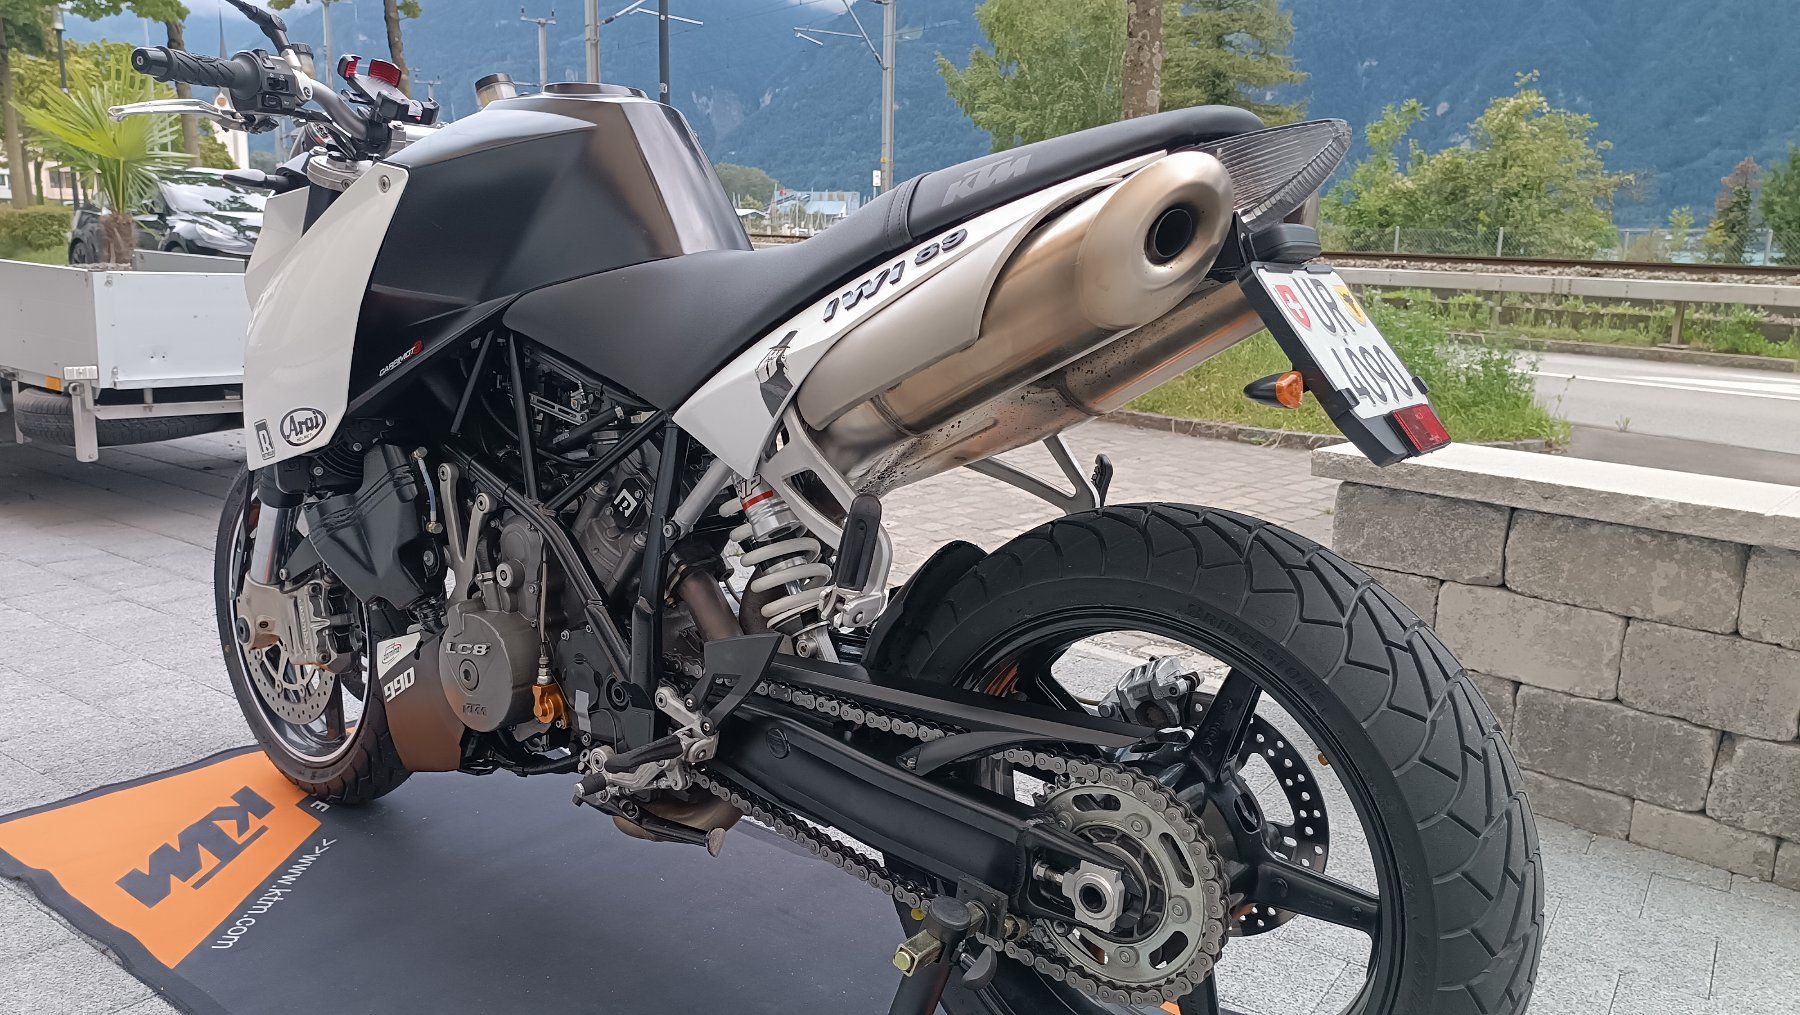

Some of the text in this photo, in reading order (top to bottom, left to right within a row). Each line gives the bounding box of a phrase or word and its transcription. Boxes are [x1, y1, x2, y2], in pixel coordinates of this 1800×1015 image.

[940, 154, 1032, 208] KTM
[914, 228, 968, 265] 89
[1291, 277, 1356, 335] UR
[1331, 344, 1413, 408] 4090
[285, 410, 320, 440] Arai
[445, 641, 492, 656] LC8
[383, 666, 416, 703] 990
[115, 785, 276, 909] KTM
